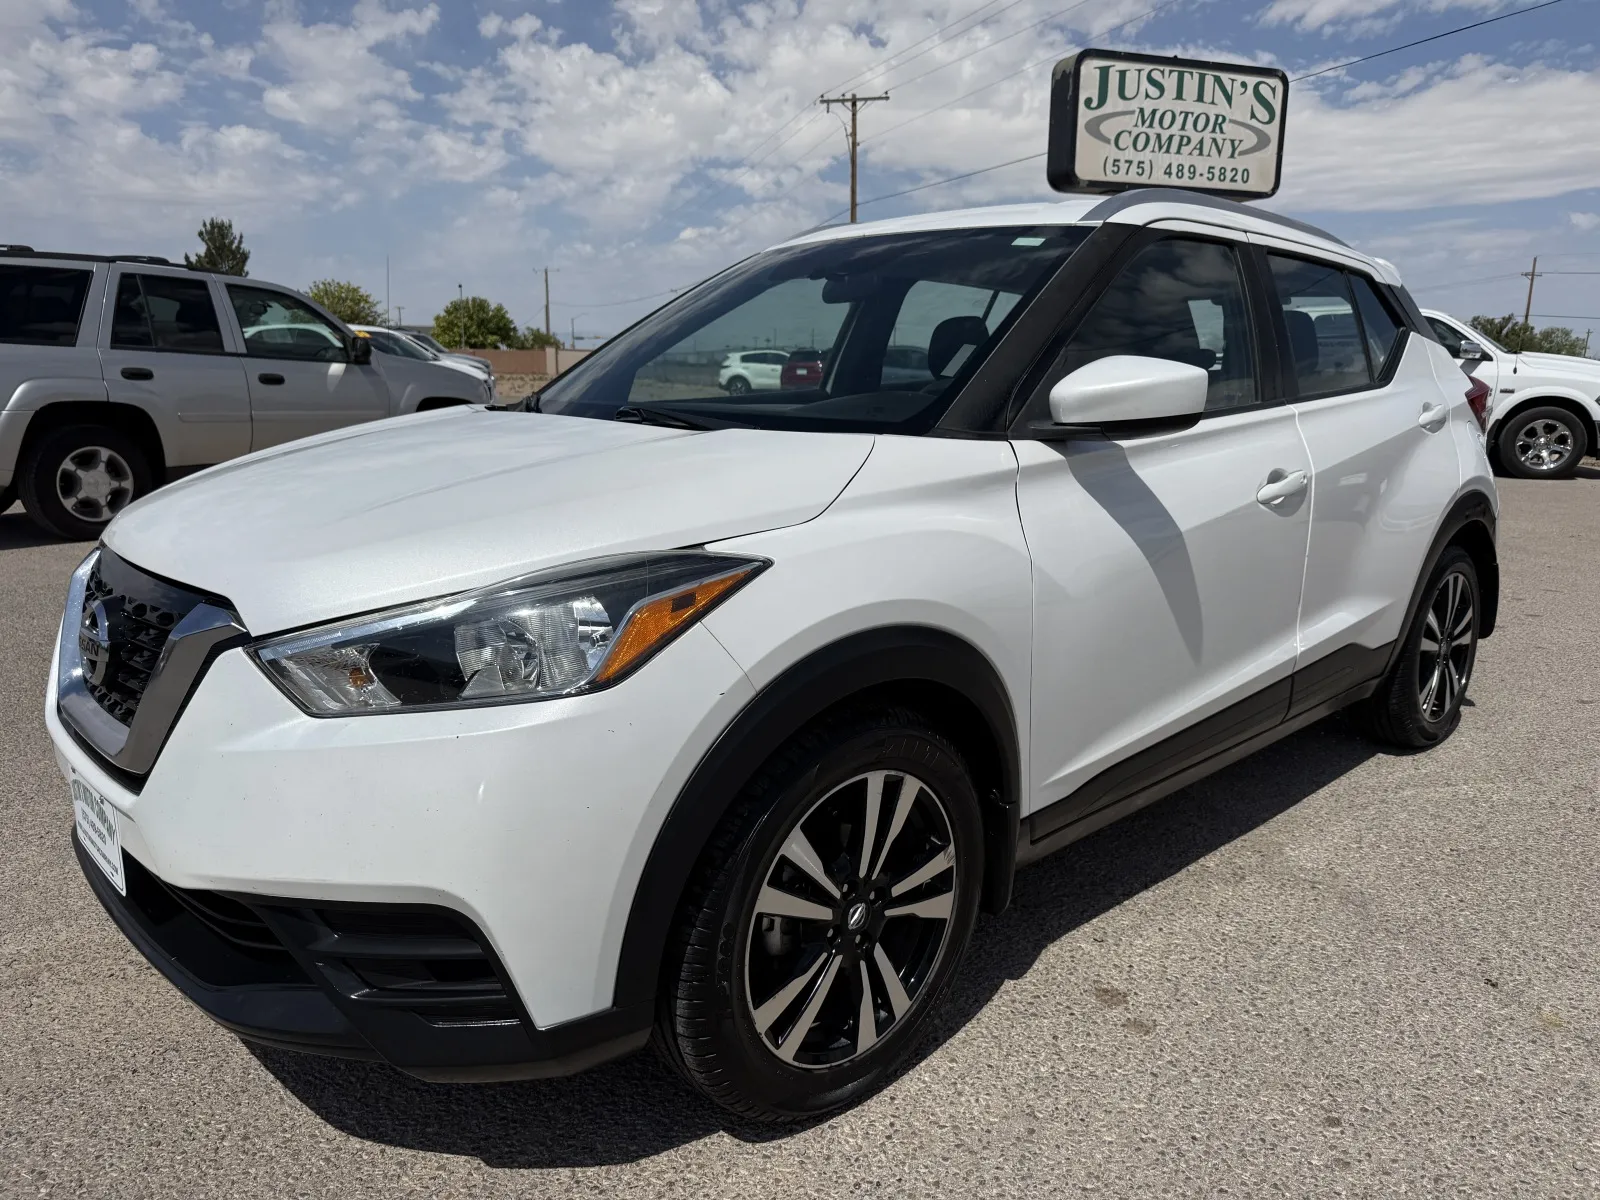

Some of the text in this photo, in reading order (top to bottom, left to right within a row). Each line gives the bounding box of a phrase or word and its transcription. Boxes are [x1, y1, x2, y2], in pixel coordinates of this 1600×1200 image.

[1084, 64, 1277, 125] JUSTIN'S
[1132, 107, 1227, 134] MOTOR
[1114, 129, 1244, 159] COMPANY
[1103, 156, 1250, 184] (575) 489-5820
